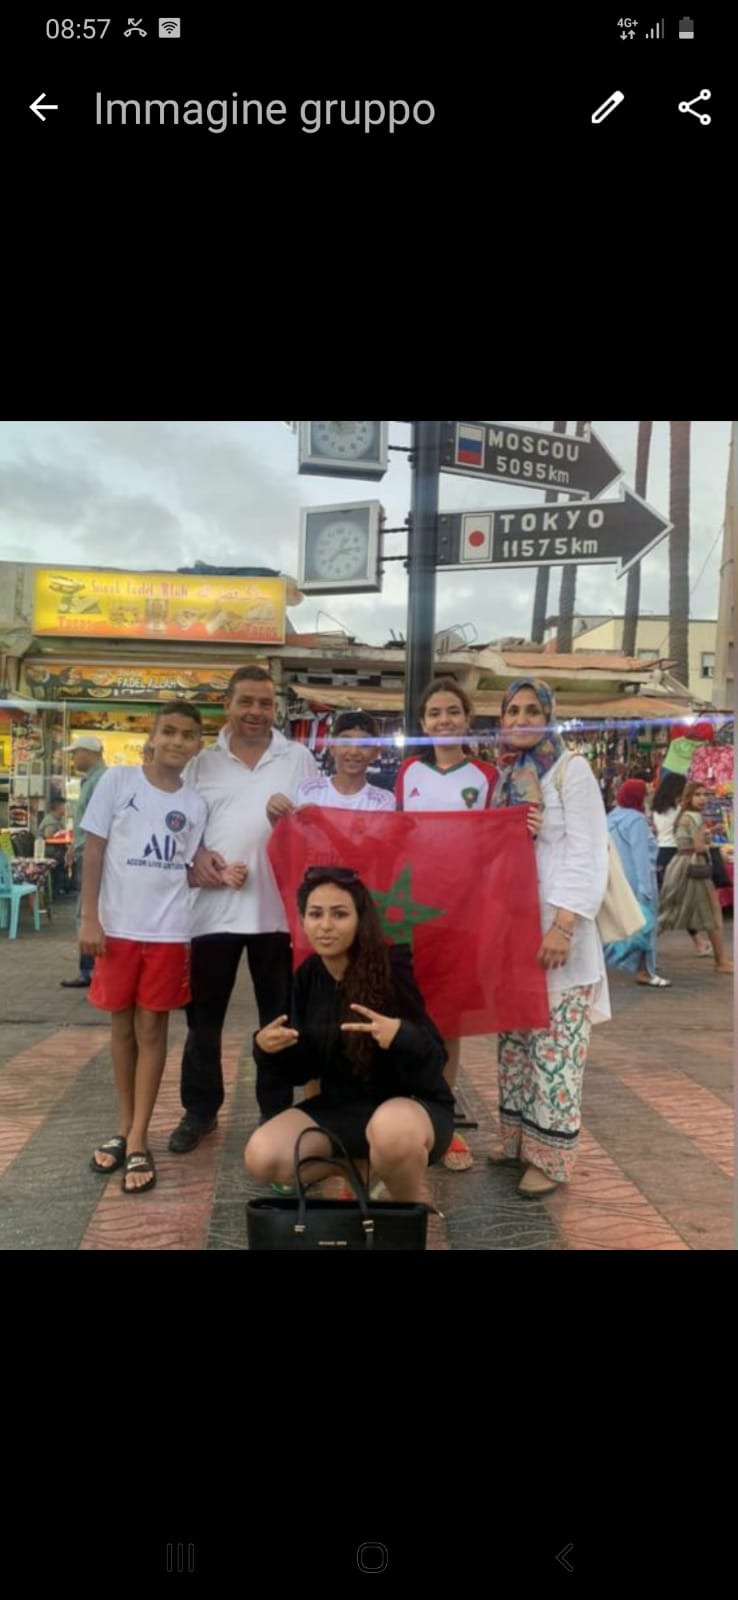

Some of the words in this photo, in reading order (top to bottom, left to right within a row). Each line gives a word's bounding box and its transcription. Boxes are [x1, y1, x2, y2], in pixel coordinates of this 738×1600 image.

[488, 430, 580, 461] MOSCOU
[496, 456, 569, 483] 5095km
[500, 508, 606, 533] TOKYO
[503, 537, 599, 558] 11575km
